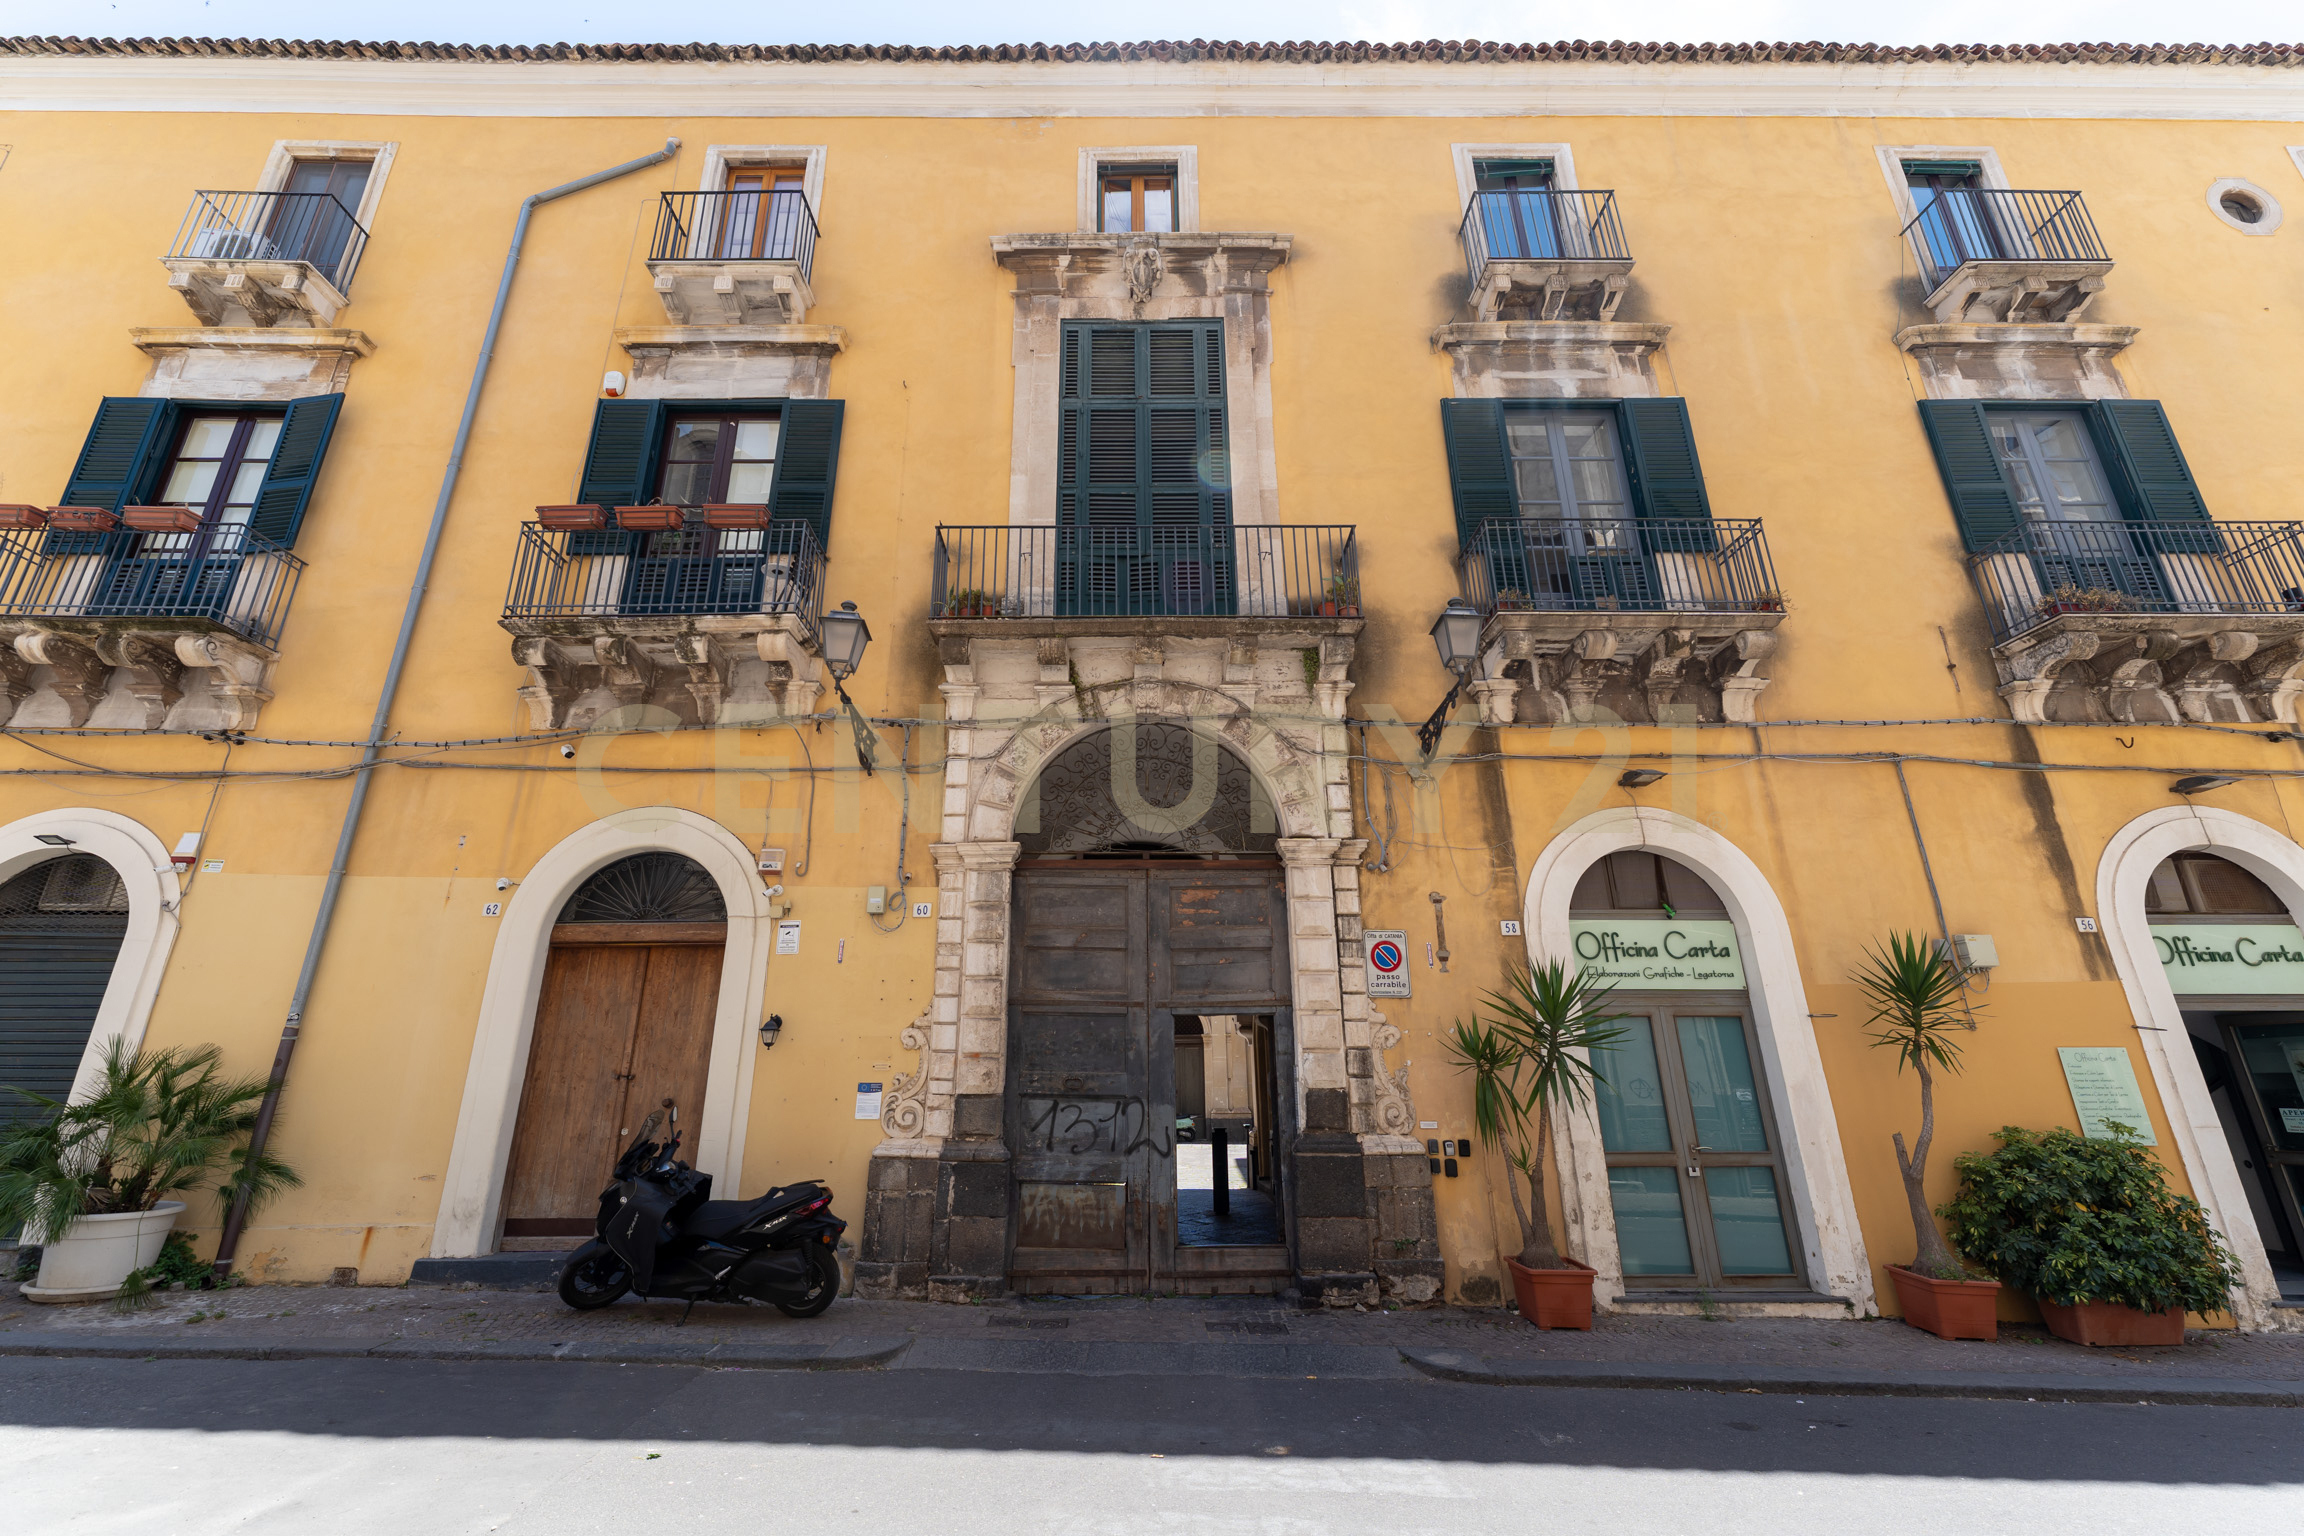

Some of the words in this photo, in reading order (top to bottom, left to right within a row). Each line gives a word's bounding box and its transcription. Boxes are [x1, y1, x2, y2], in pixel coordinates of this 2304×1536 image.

[485, 904, 499, 915] 62
[916, 904, 928, 915] 60
[1505, 922, 1517, 934] 58
[2081, 919, 2094, 931] 56
[1575, 931, 1659, 963] Officina
[1664, 930, 1730, 959] Carta
[2152, 935, 2234, 966] Officina
[2235, 936, 2304, 966] Carta
[1587, 966, 1641, 979] Elaborazioni
[1643, 966, 1684, 980] Grafiche
[1693, 967, 1735, 980] Legatoria
